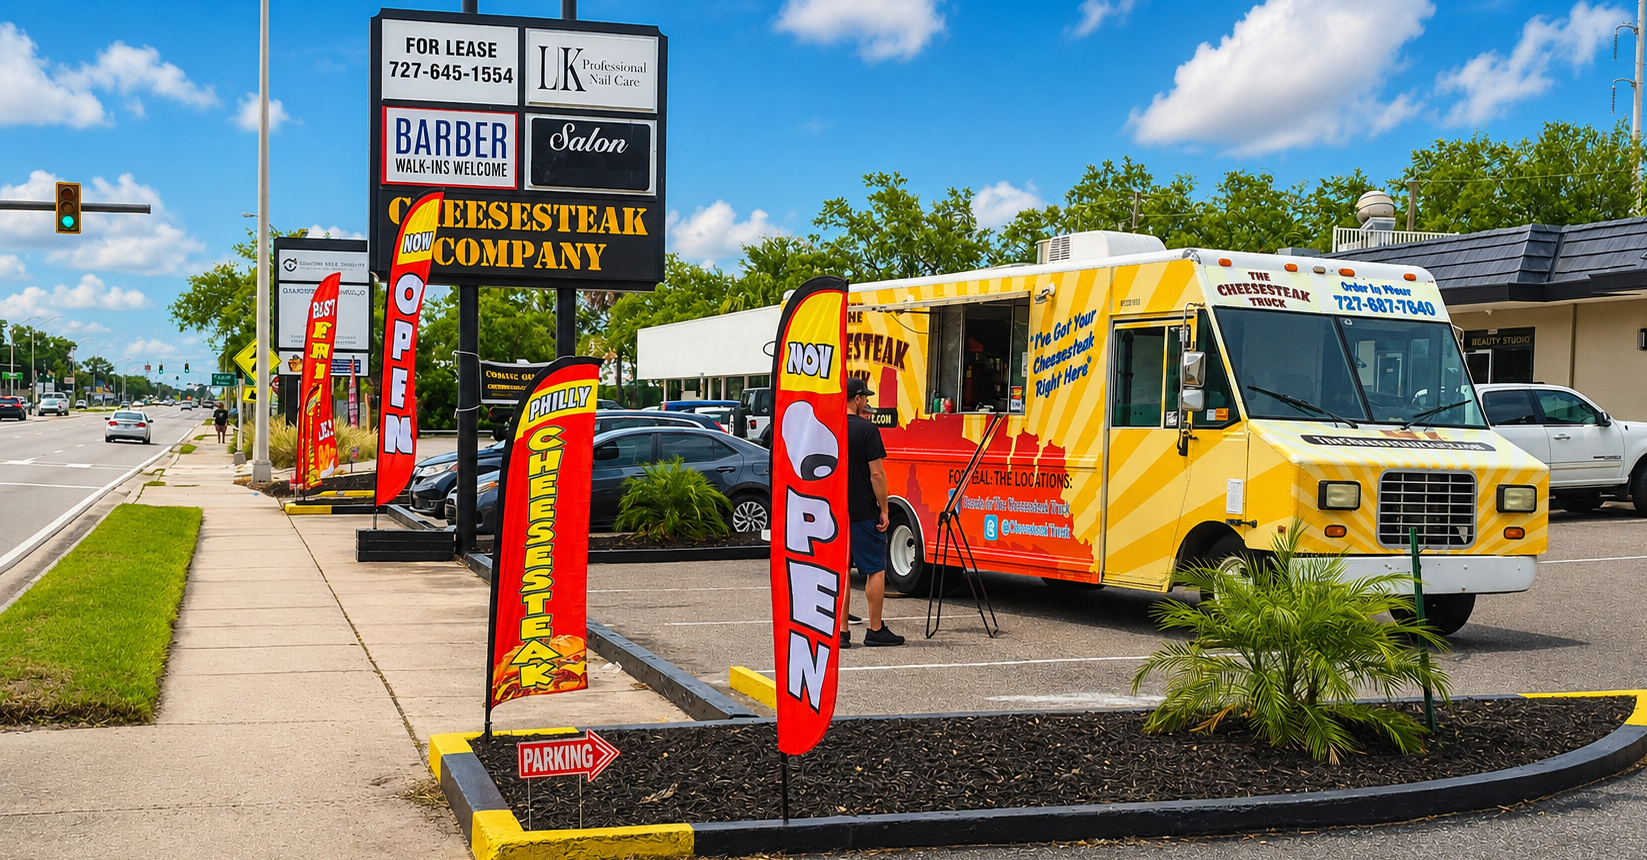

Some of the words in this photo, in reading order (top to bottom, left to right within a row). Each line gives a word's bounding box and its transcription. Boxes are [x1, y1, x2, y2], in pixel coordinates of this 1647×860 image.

[406, 37, 440, 55] FOR
[446, 39, 498, 59] LEASE
[389, 61, 514, 84] 727-645-1554
[537, 45, 587, 92] LK
[582, 59, 647, 74] Professional
[589, 73, 610, 85] Nail
[614, 75, 640, 88] Care
[395, 117, 508, 159] BARBER
[549, 122, 629, 154] Salon
[395, 158, 450, 175] WALK-INS
[453, 161, 508, 178] WELCOME
[388, 196, 649, 236] CEESESTEAK
[402, 231, 434, 254] NOW
[432, 237, 607, 271] COMPANY
[1247, 271, 1271, 281] THE
[1216, 283, 1312, 303] CHEESESTEAK
[1248, 297, 1288, 309] TRUCK
[1333, 295, 1436, 316] 727-687-7640
[1053, 317, 1072, 341] Got
[1074, 309, 1097, 332] Your
[1502, 335, 1531, 345] STUDIO
[383, 272, 425, 455] OPEN
[1035, 370, 1063, 399] Right
[528, 384, 593, 423] PHILLY
[1014, 471, 1073, 489] LOCATIONS:
[510, 425, 567, 690] CHEESESTEAK
[523, 743, 593, 773] PARKING
